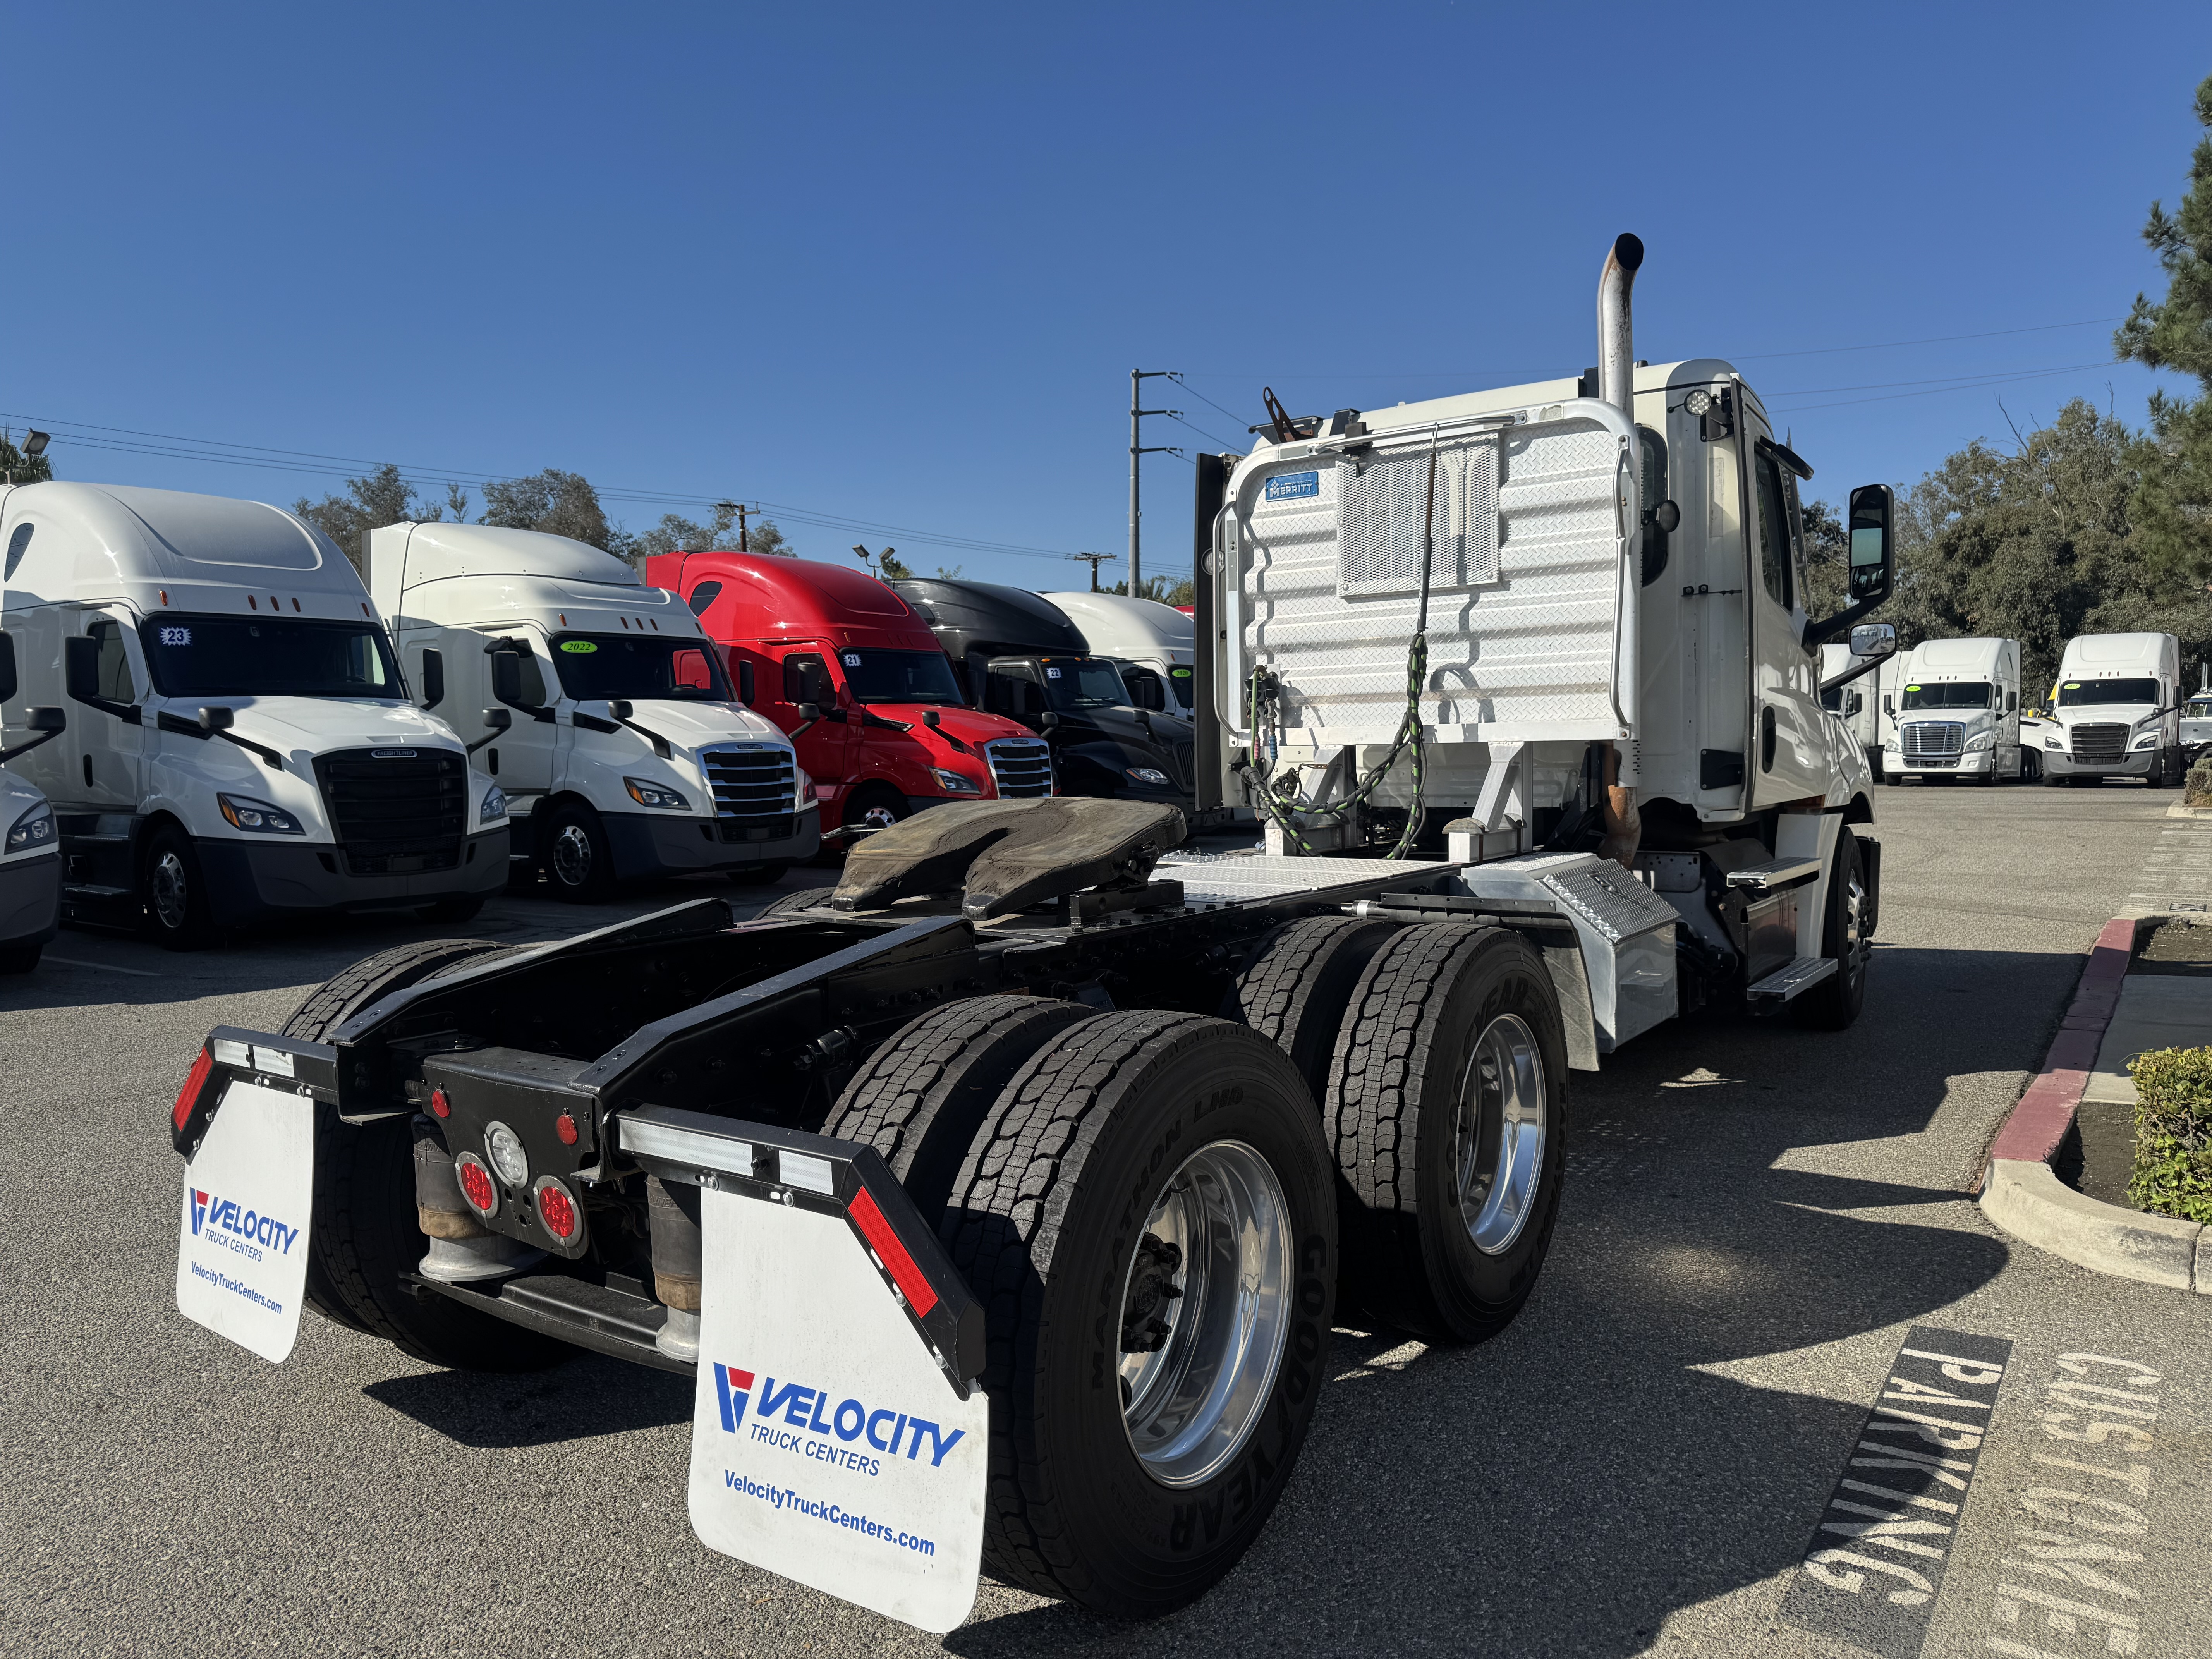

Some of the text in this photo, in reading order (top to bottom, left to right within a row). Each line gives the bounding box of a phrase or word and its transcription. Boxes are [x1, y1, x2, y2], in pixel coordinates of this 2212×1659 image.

[1270, 484, 1312, 498] MERRITT
[168, 630, 184, 642] 23
[205, 1228, 263, 1262] TRUCK CENTERS
[209, 1196, 299, 1255] VELOCITY
[1093, 1121, 1182, 1390] MARATHON
[191, 1261, 282, 1314] VelocityTruckCenters.com
[751, 1424, 880, 1476] TRUCK CENTERS
[757, 1377, 966, 1467] VELOCITY
[1803, 1348, 2004, 1606] PARKING
[725, 1470, 935, 1556] VelocityTruckCenters.com
